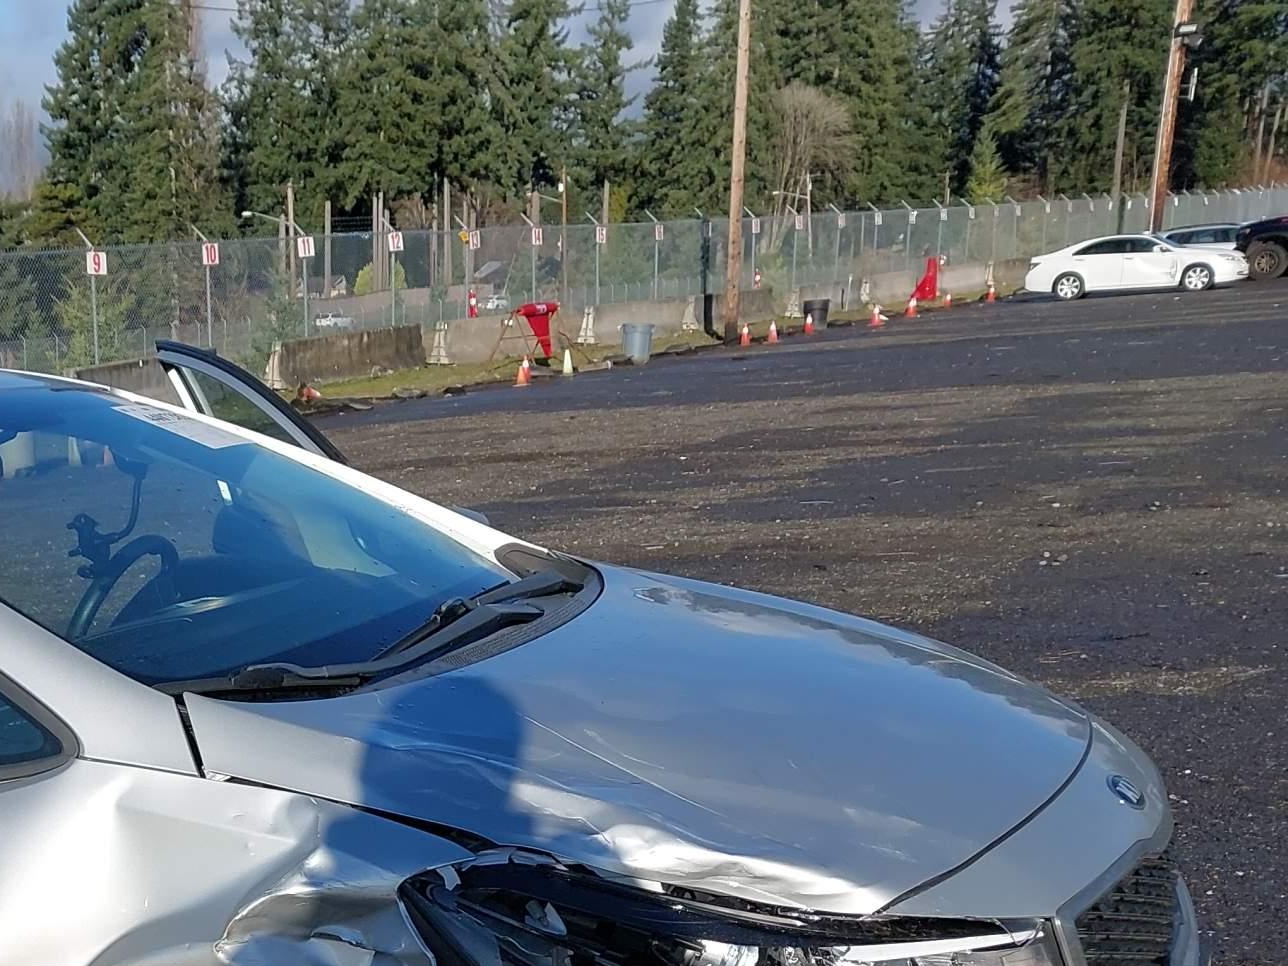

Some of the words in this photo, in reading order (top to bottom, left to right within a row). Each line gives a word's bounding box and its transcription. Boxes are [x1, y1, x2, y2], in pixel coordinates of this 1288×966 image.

[302, 238, 311, 255] 11
[391, 233, 401, 249] 12
[471, 231, 479, 248] 13
[205, 244, 217, 263] 10
[93, 253, 101, 273] 9
